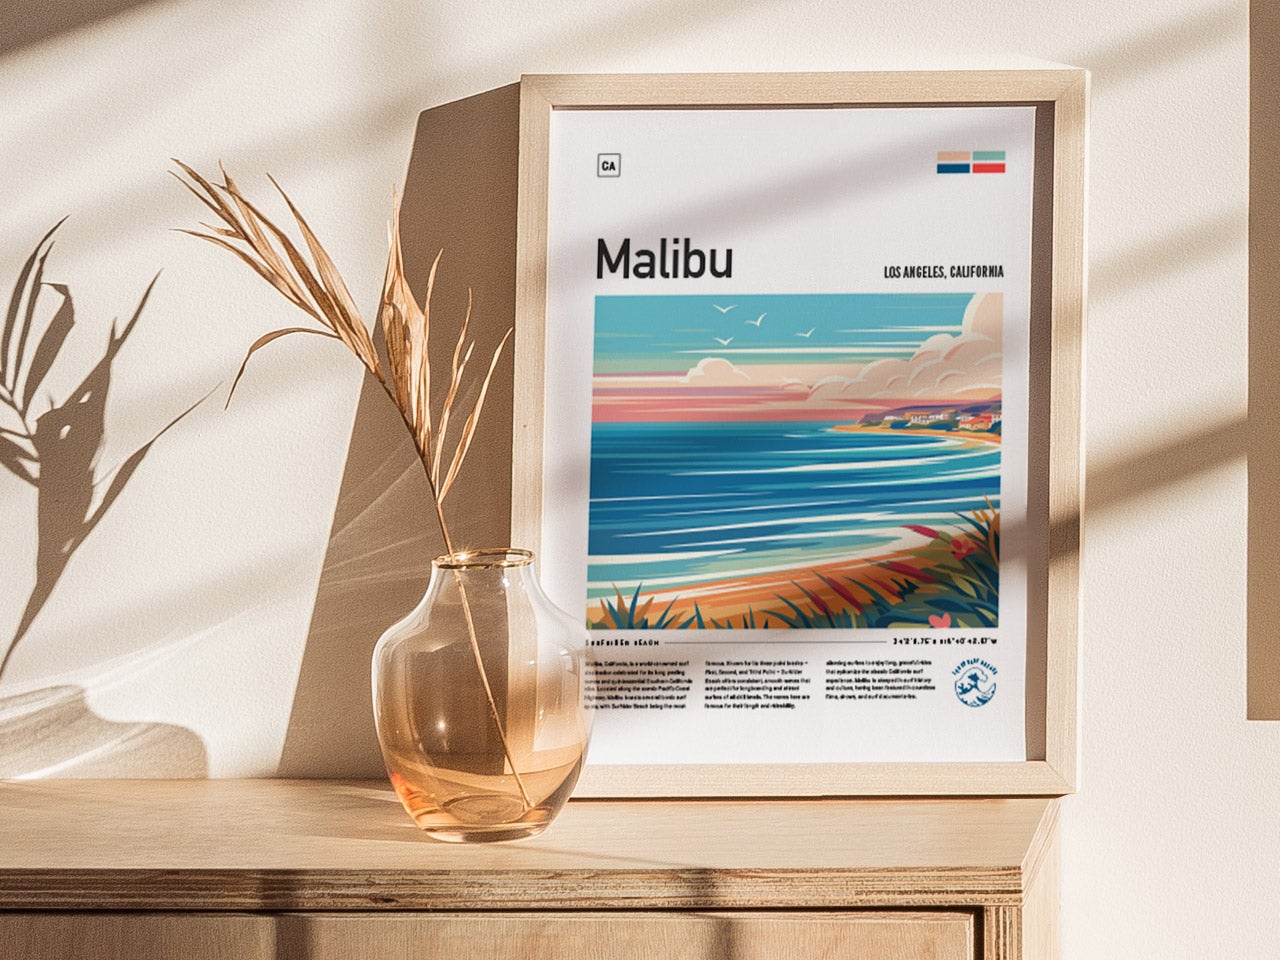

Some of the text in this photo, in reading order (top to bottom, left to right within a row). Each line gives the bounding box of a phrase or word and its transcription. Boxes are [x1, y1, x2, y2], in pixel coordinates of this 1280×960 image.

[602, 161, 615, 171] CA
[597, 238, 732, 279] Malibu
[884, 265, 1004, 279] LOS ANGELES, CALIFORNIA
